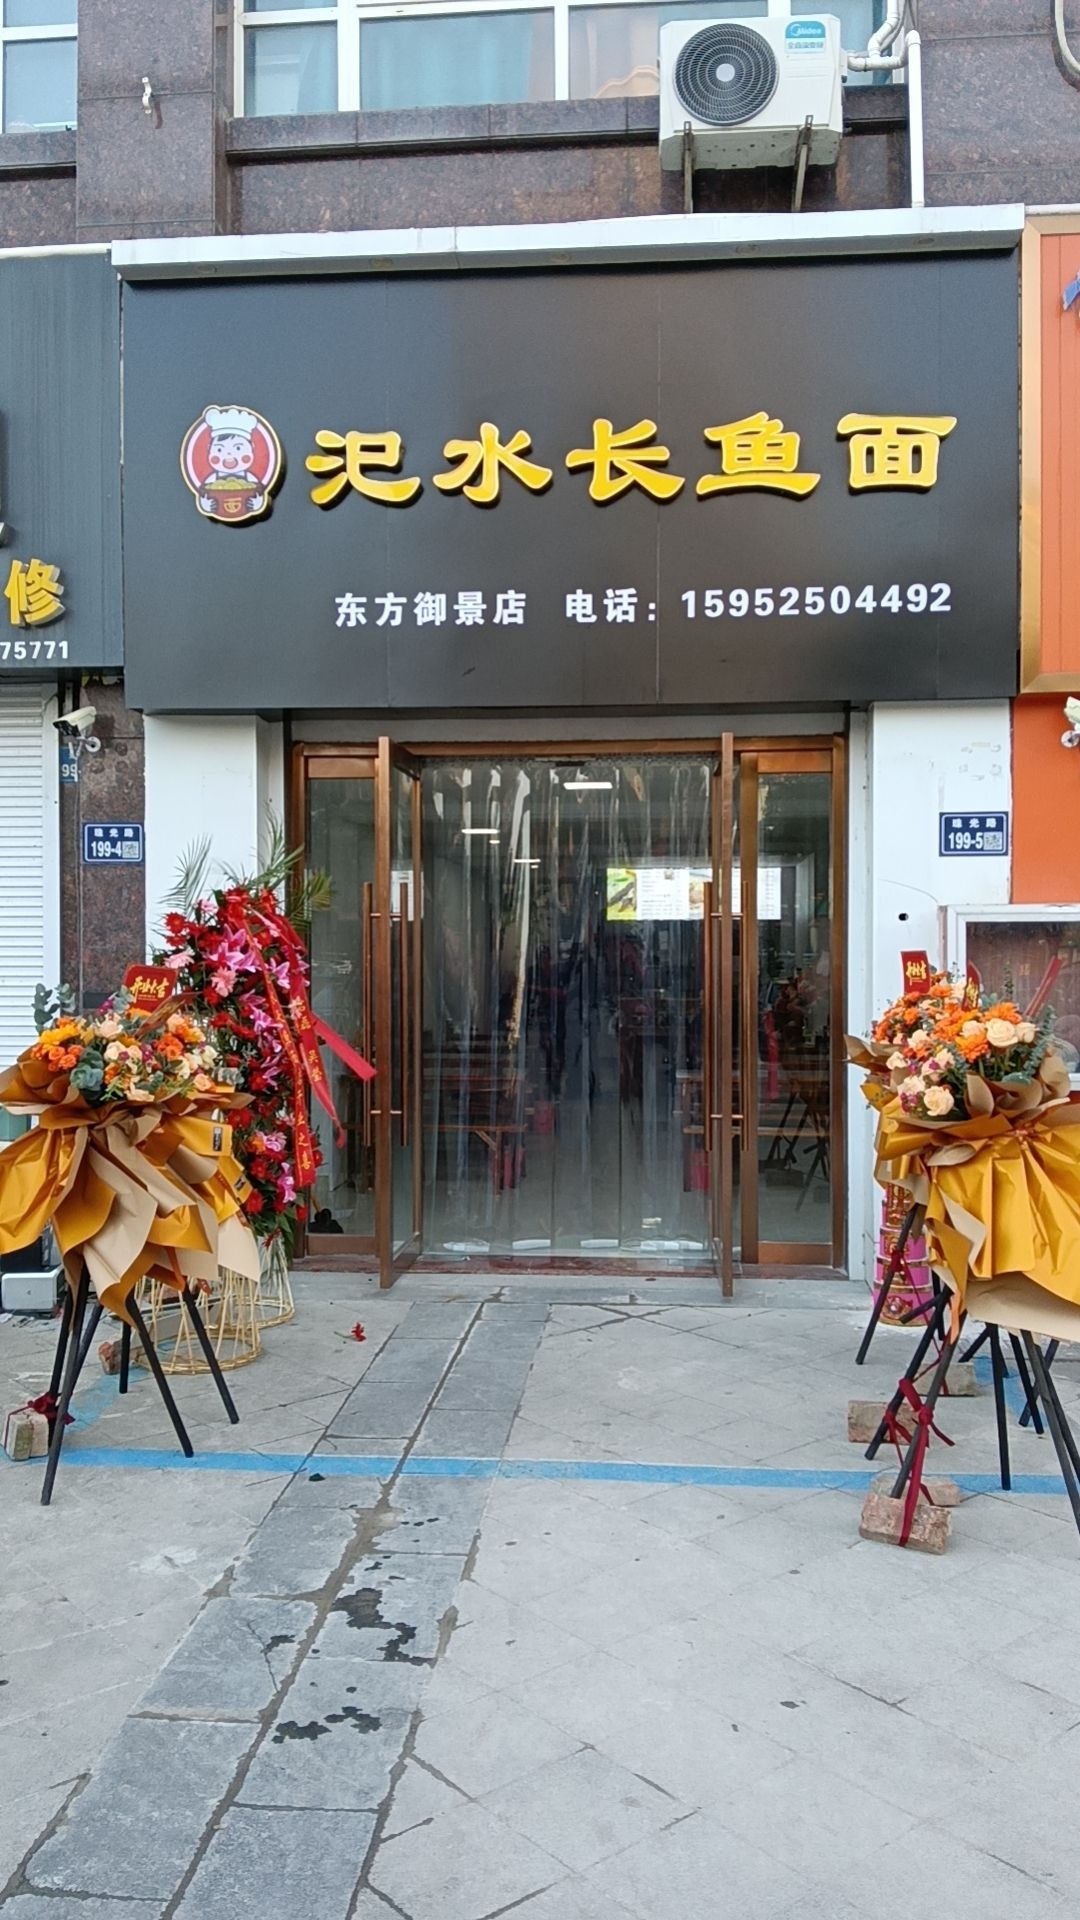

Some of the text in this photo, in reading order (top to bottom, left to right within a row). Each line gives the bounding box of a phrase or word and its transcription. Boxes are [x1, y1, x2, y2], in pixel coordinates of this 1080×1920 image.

[4, 558, 65, 627] 修
[334, 589, 527, 628] 东方御景店
[681, 581, 952, 619] 15952504492
[91, 840, 122, 858] 199-4
[948, 831, 984, 850] 199-5
